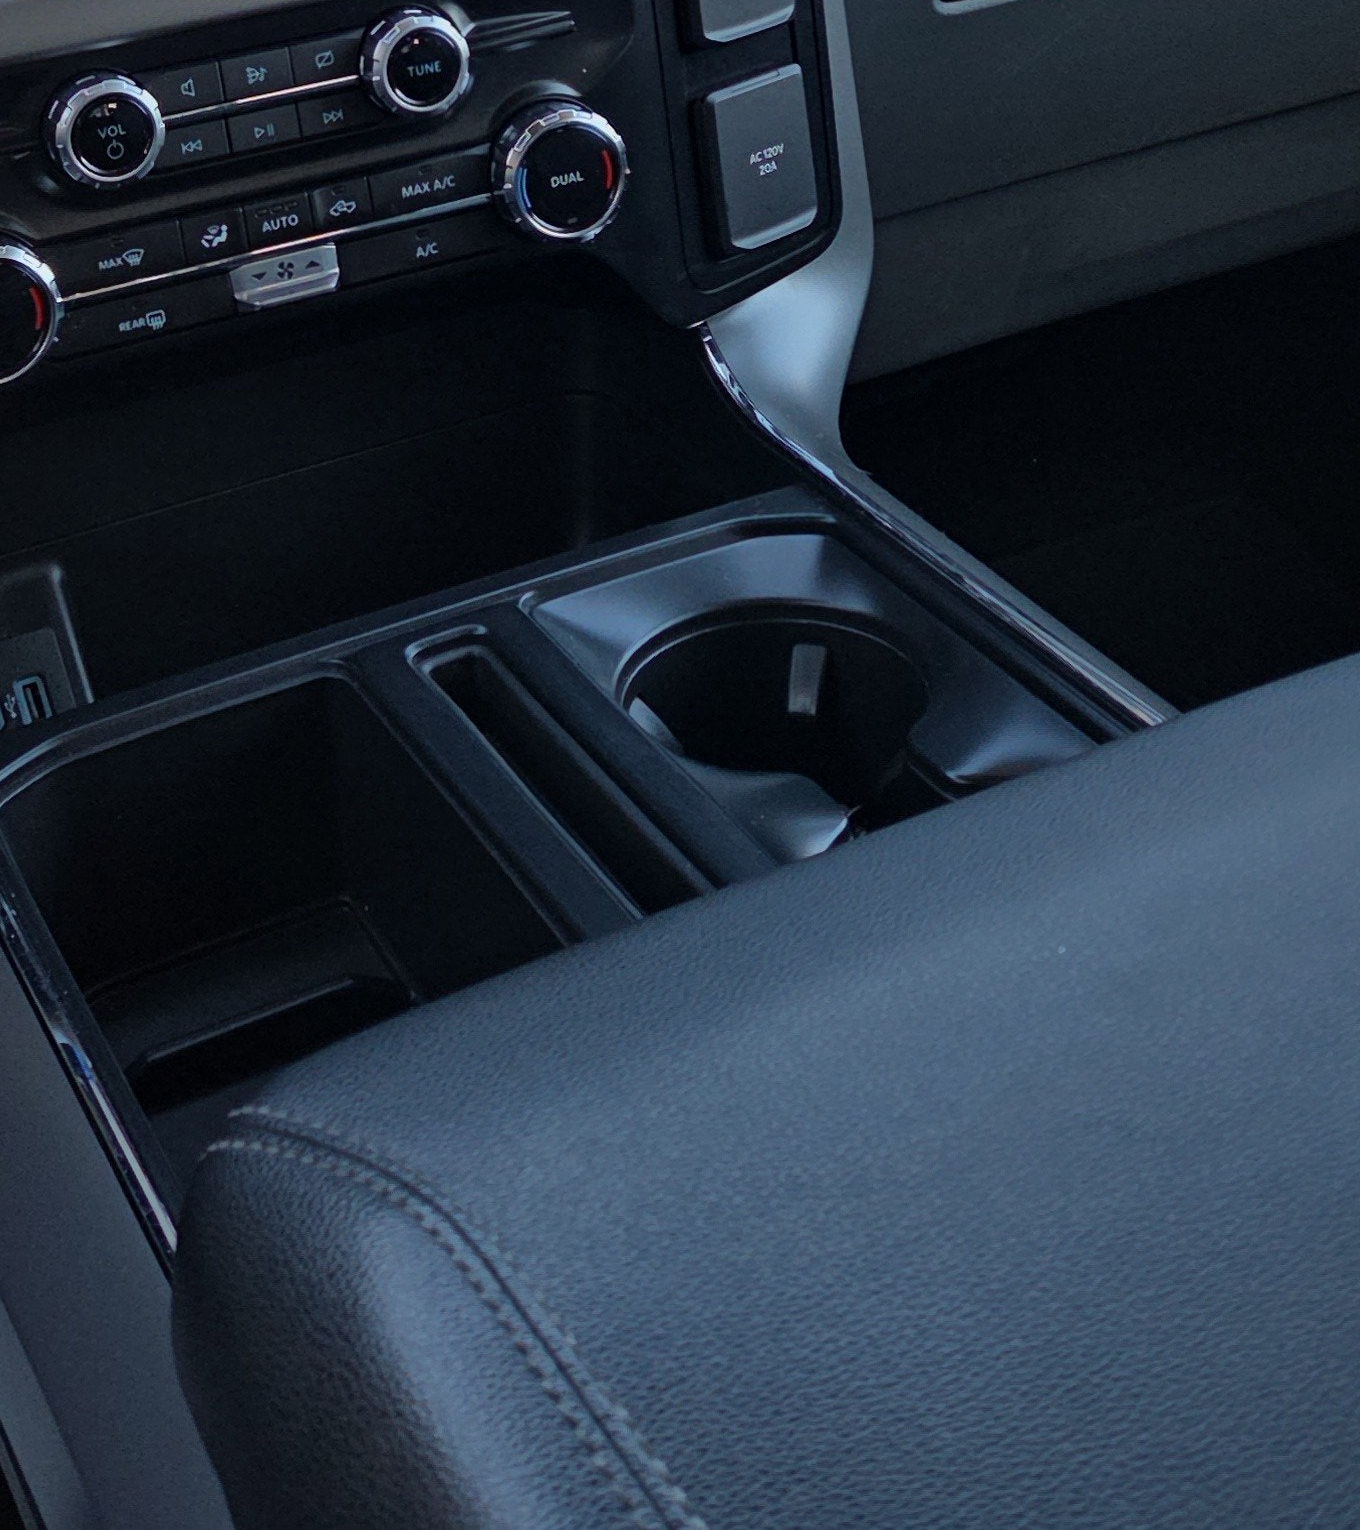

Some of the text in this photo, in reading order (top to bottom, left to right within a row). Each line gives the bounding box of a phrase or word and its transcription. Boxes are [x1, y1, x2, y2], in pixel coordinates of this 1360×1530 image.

[407, 60, 442, 78] TUNE
[97, 123, 127, 140] VOL
[401, 175, 456, 199] MAX A/C
[550, 171, 585, 188] DUAL
[262, 213, 299, 233] AUTO
[416, 242, 439, 259] A/C
[98, 256, 124, 271] MAX
[118, 316, 146, 333] REAR
